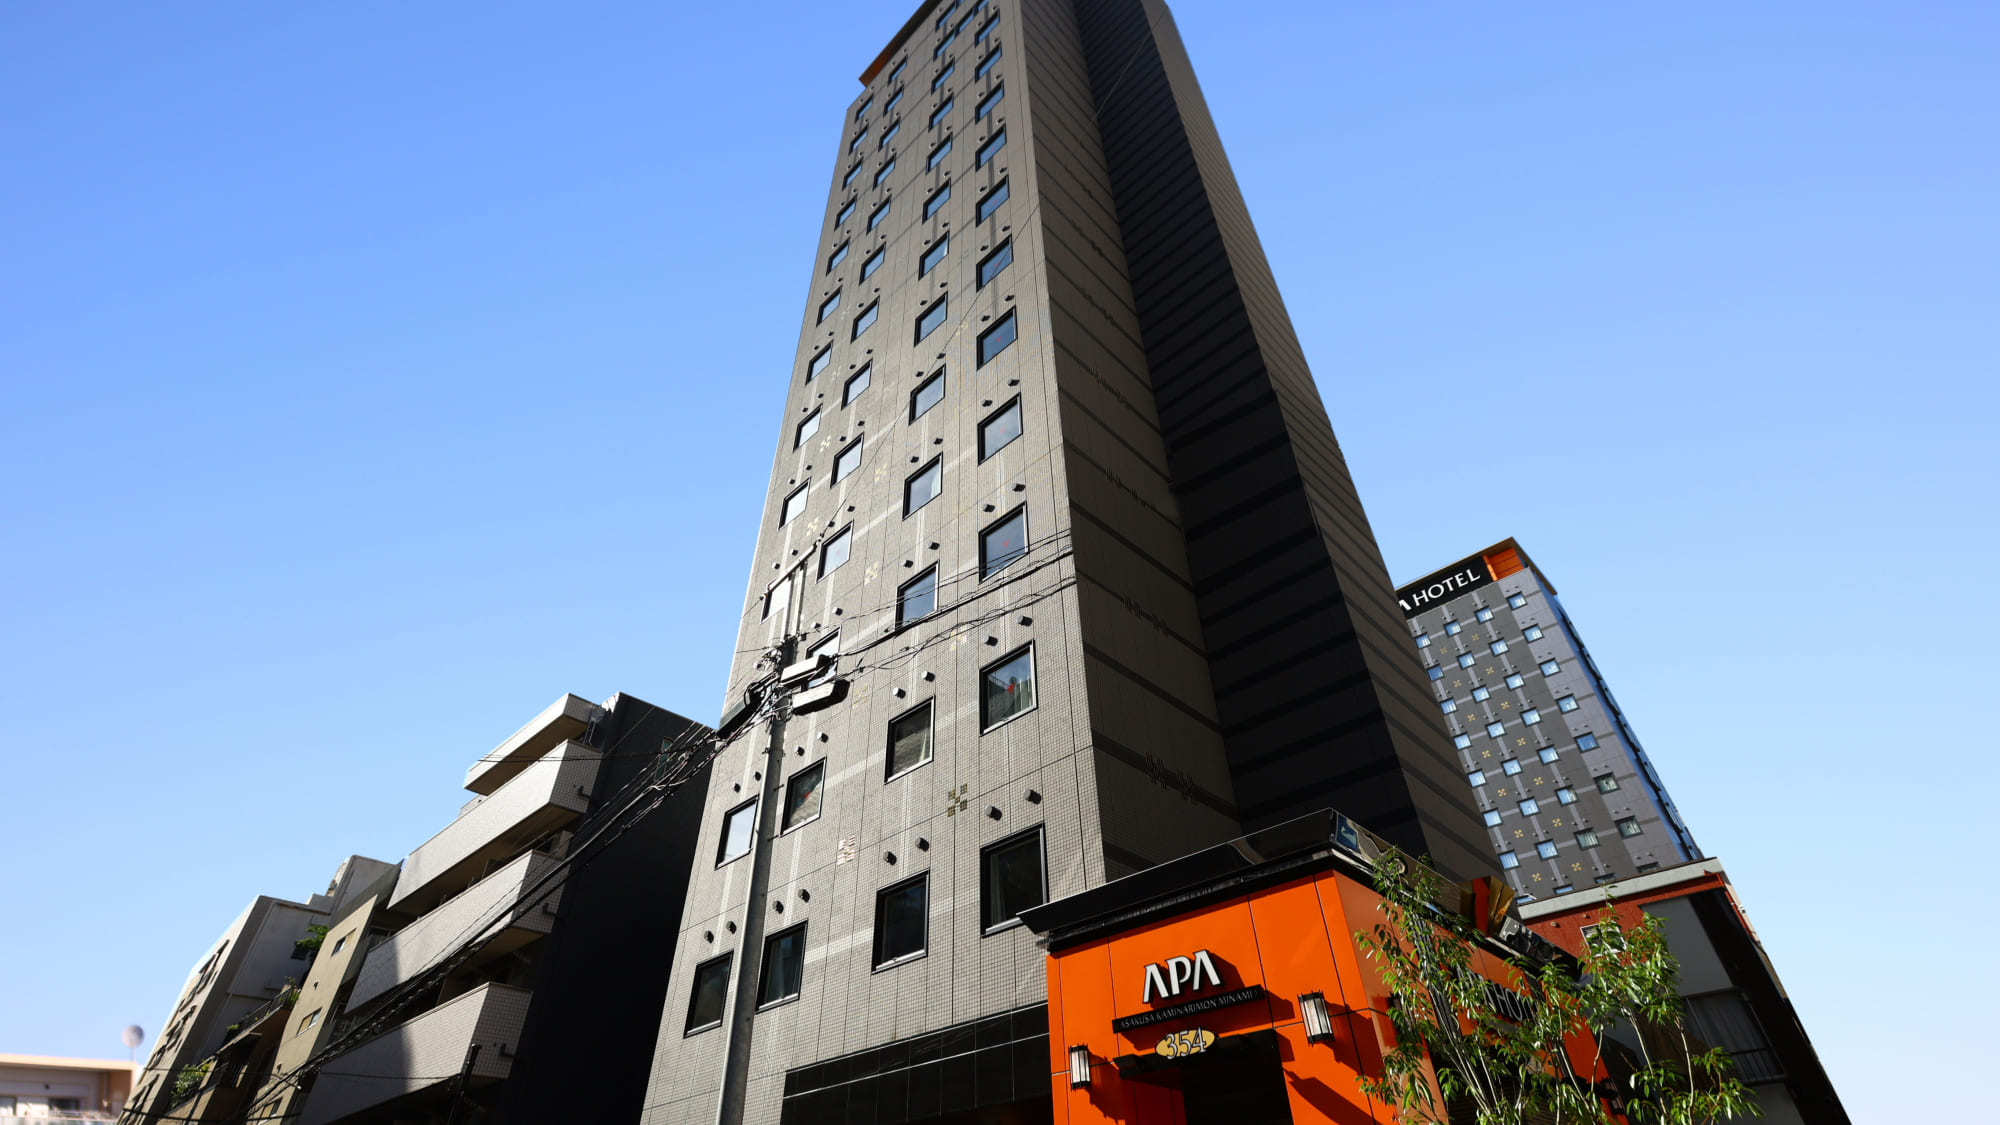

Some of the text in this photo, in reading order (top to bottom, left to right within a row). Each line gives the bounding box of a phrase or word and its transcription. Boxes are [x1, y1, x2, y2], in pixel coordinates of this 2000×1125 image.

[1412, 569, 1481, 607] HOTEL
[1142, 949, 1221, 1004] APA
[1120, 990, 1254, 1029] ASAKUSA KAMINARIMON MINAMI
[1166, 1027, 1207, 1060] 354
